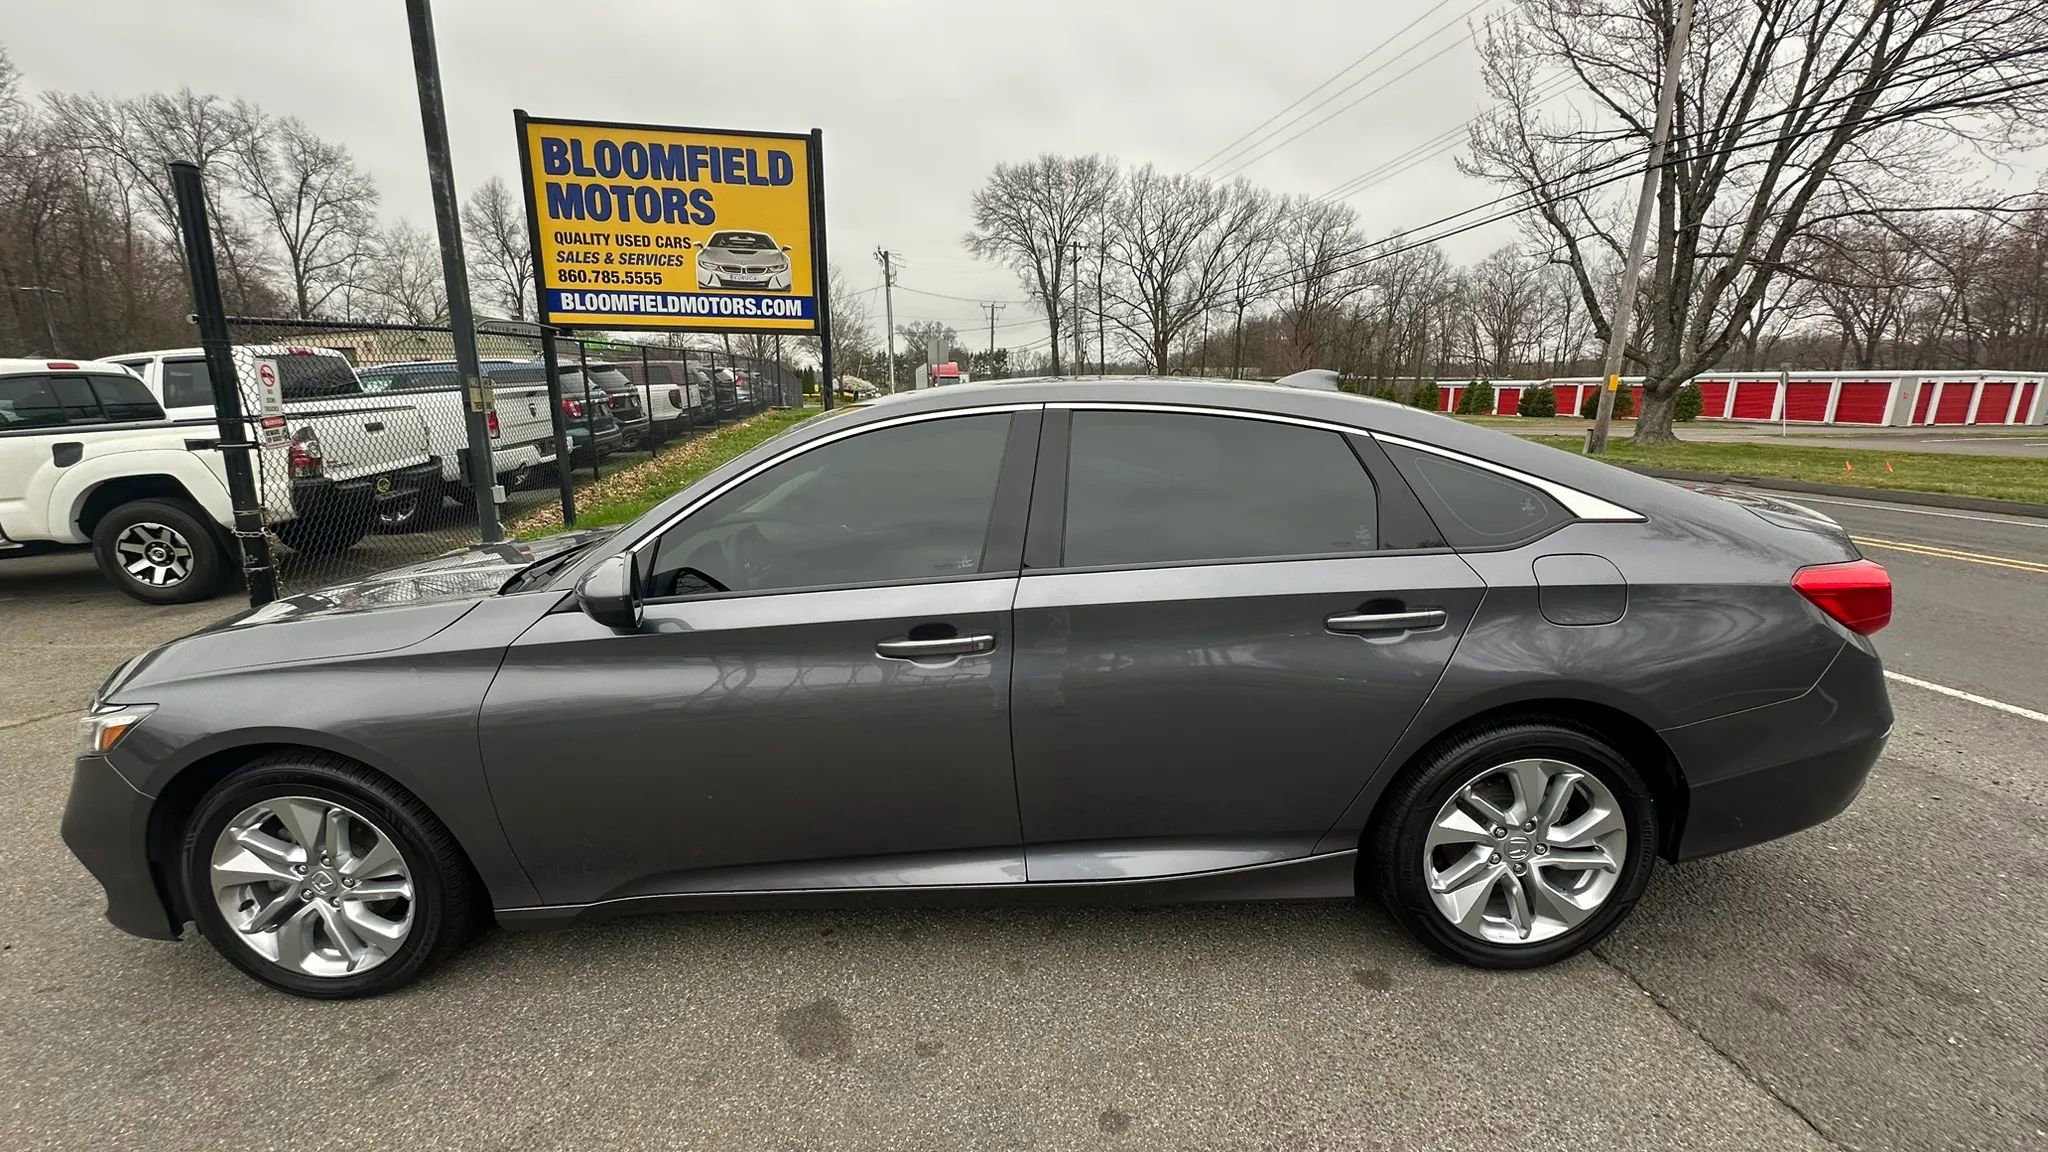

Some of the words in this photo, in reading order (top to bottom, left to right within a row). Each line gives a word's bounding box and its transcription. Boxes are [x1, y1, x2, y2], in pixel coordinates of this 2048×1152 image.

[541, 137, 793, 186] BLOOMFIELD
[546, 182, 715, 225] MOTORS
[554, 232, 611, 247] QUALITY
[615, 235, 651, 248] USED
[655, 236, 692, 249] CARS
[557, 251, 600, 264] SALES
[604, 253, 614, 265] &
[619, 253, 684, 267] SERVICES
[558, 270, 662, 286] 860.785.5555
[561, 293, 801, 316] BLOOMFIELDMOTORS.COM
